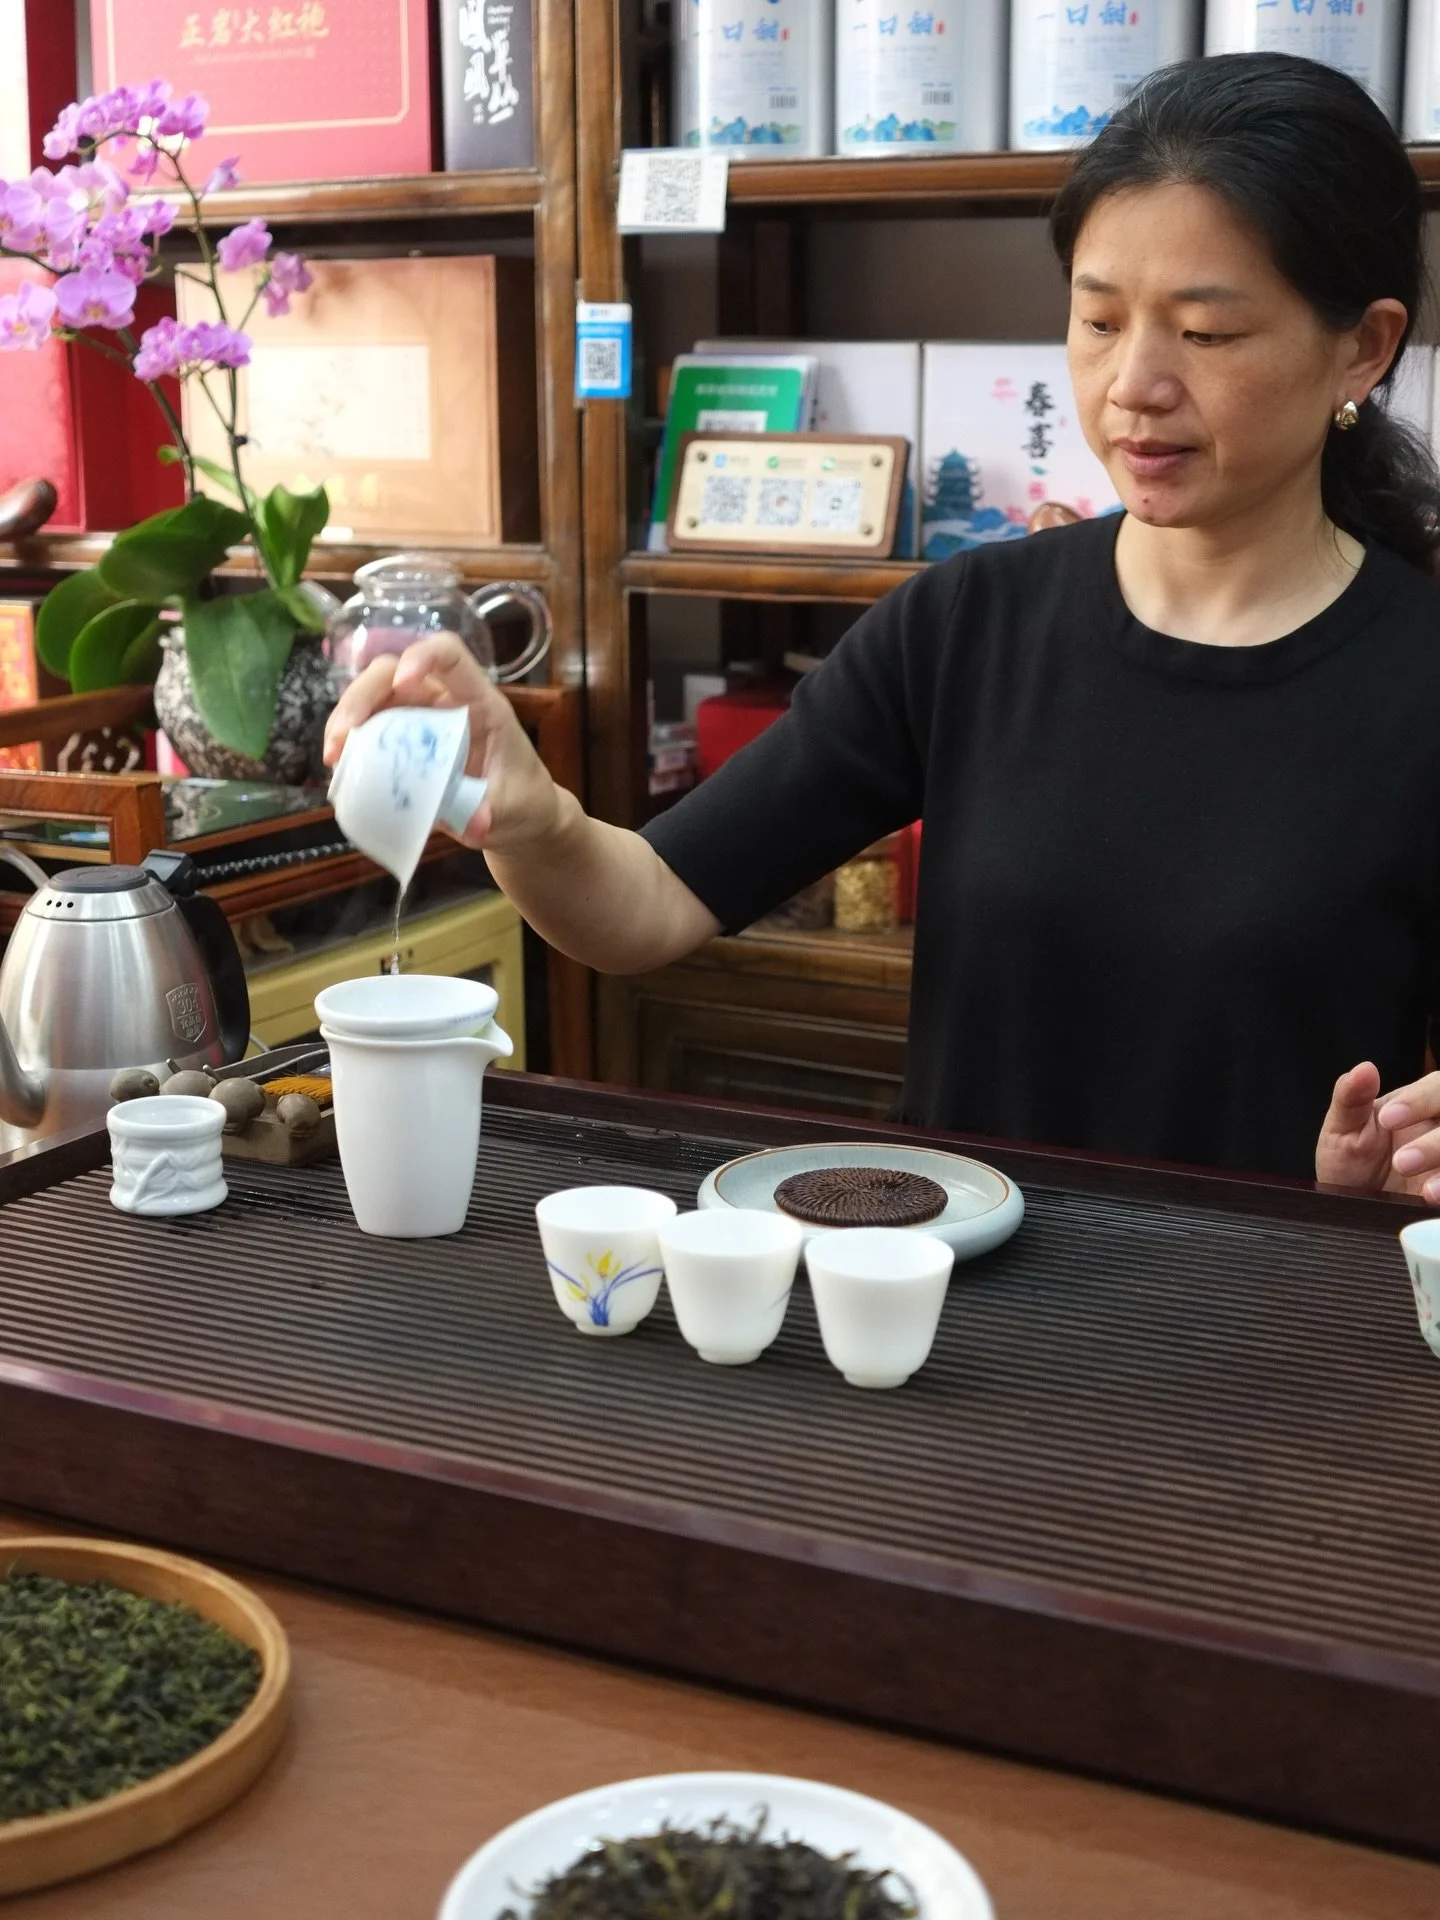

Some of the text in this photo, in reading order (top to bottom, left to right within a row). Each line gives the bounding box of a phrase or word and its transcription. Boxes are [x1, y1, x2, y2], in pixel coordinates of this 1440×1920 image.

[852, 10, 934, 37] 一口甜
[1036, 0, 1128, 27] 一口甜
